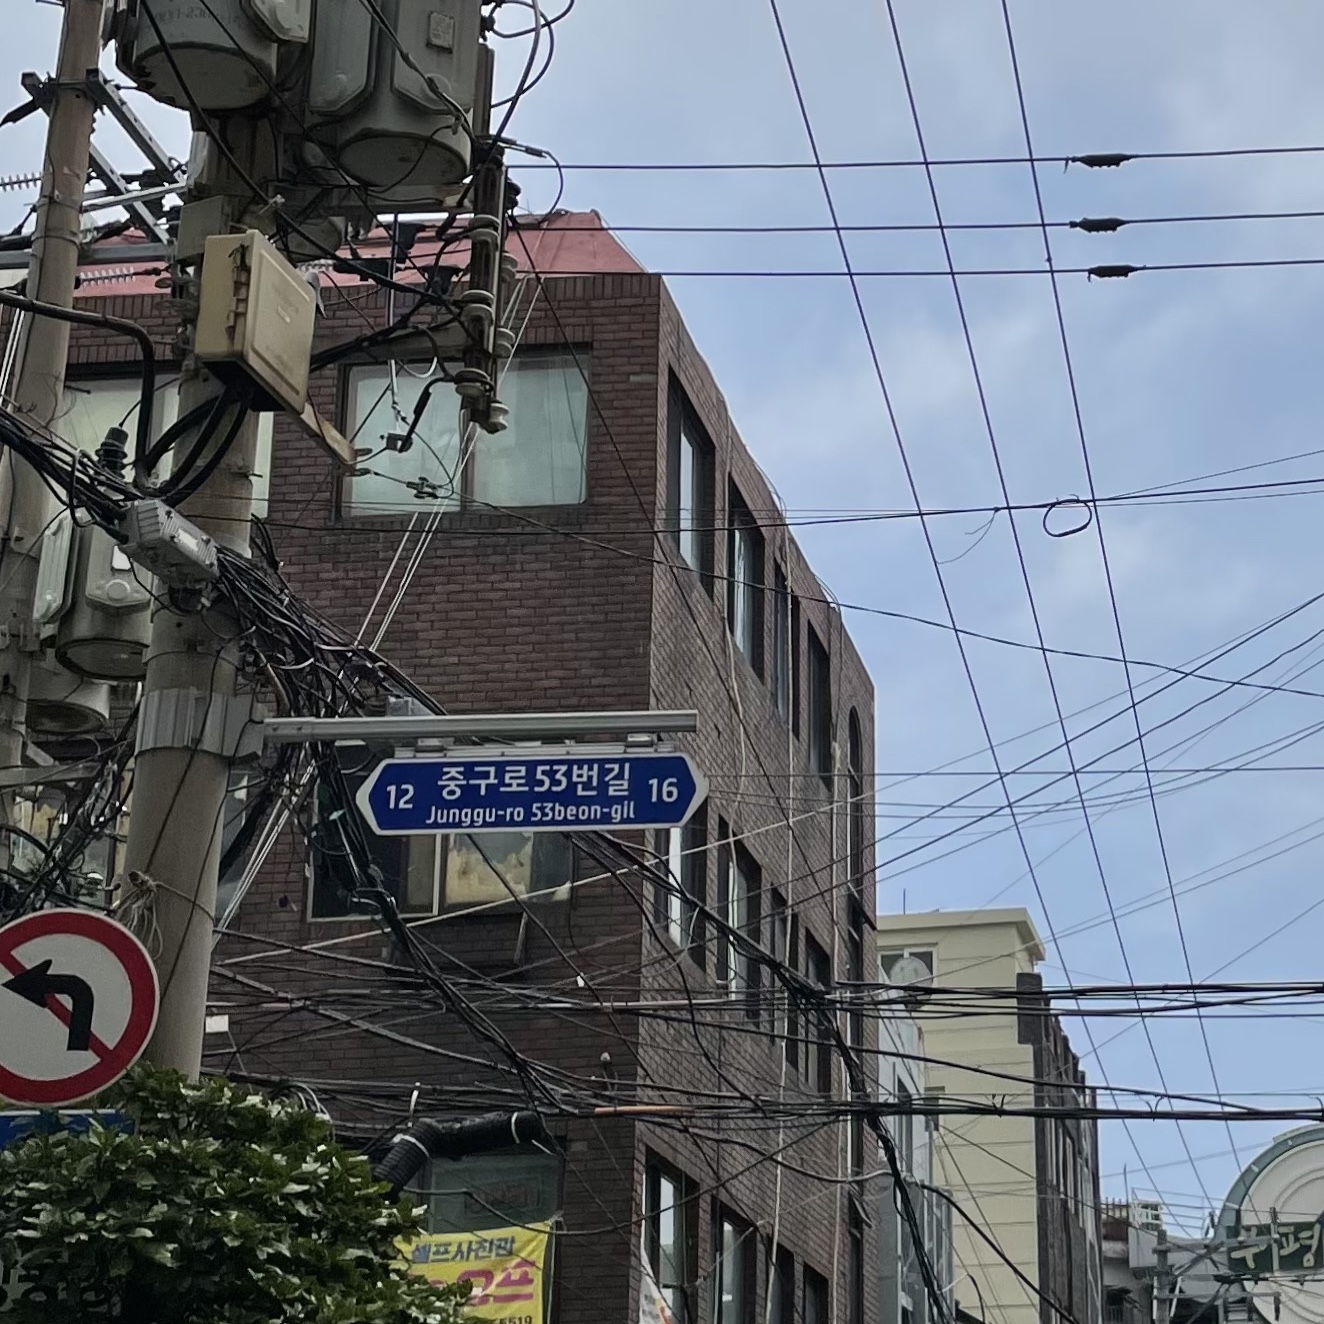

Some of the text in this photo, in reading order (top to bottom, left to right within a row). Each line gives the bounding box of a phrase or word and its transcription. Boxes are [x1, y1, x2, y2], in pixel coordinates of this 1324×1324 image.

[437, 762, 631, 800] 중구로53번길
[648, 778, 679, 803] 16
[386, 784, 415, 809] 12
[425, 802, 636, 827] Junggu-ro 53beon-gil
